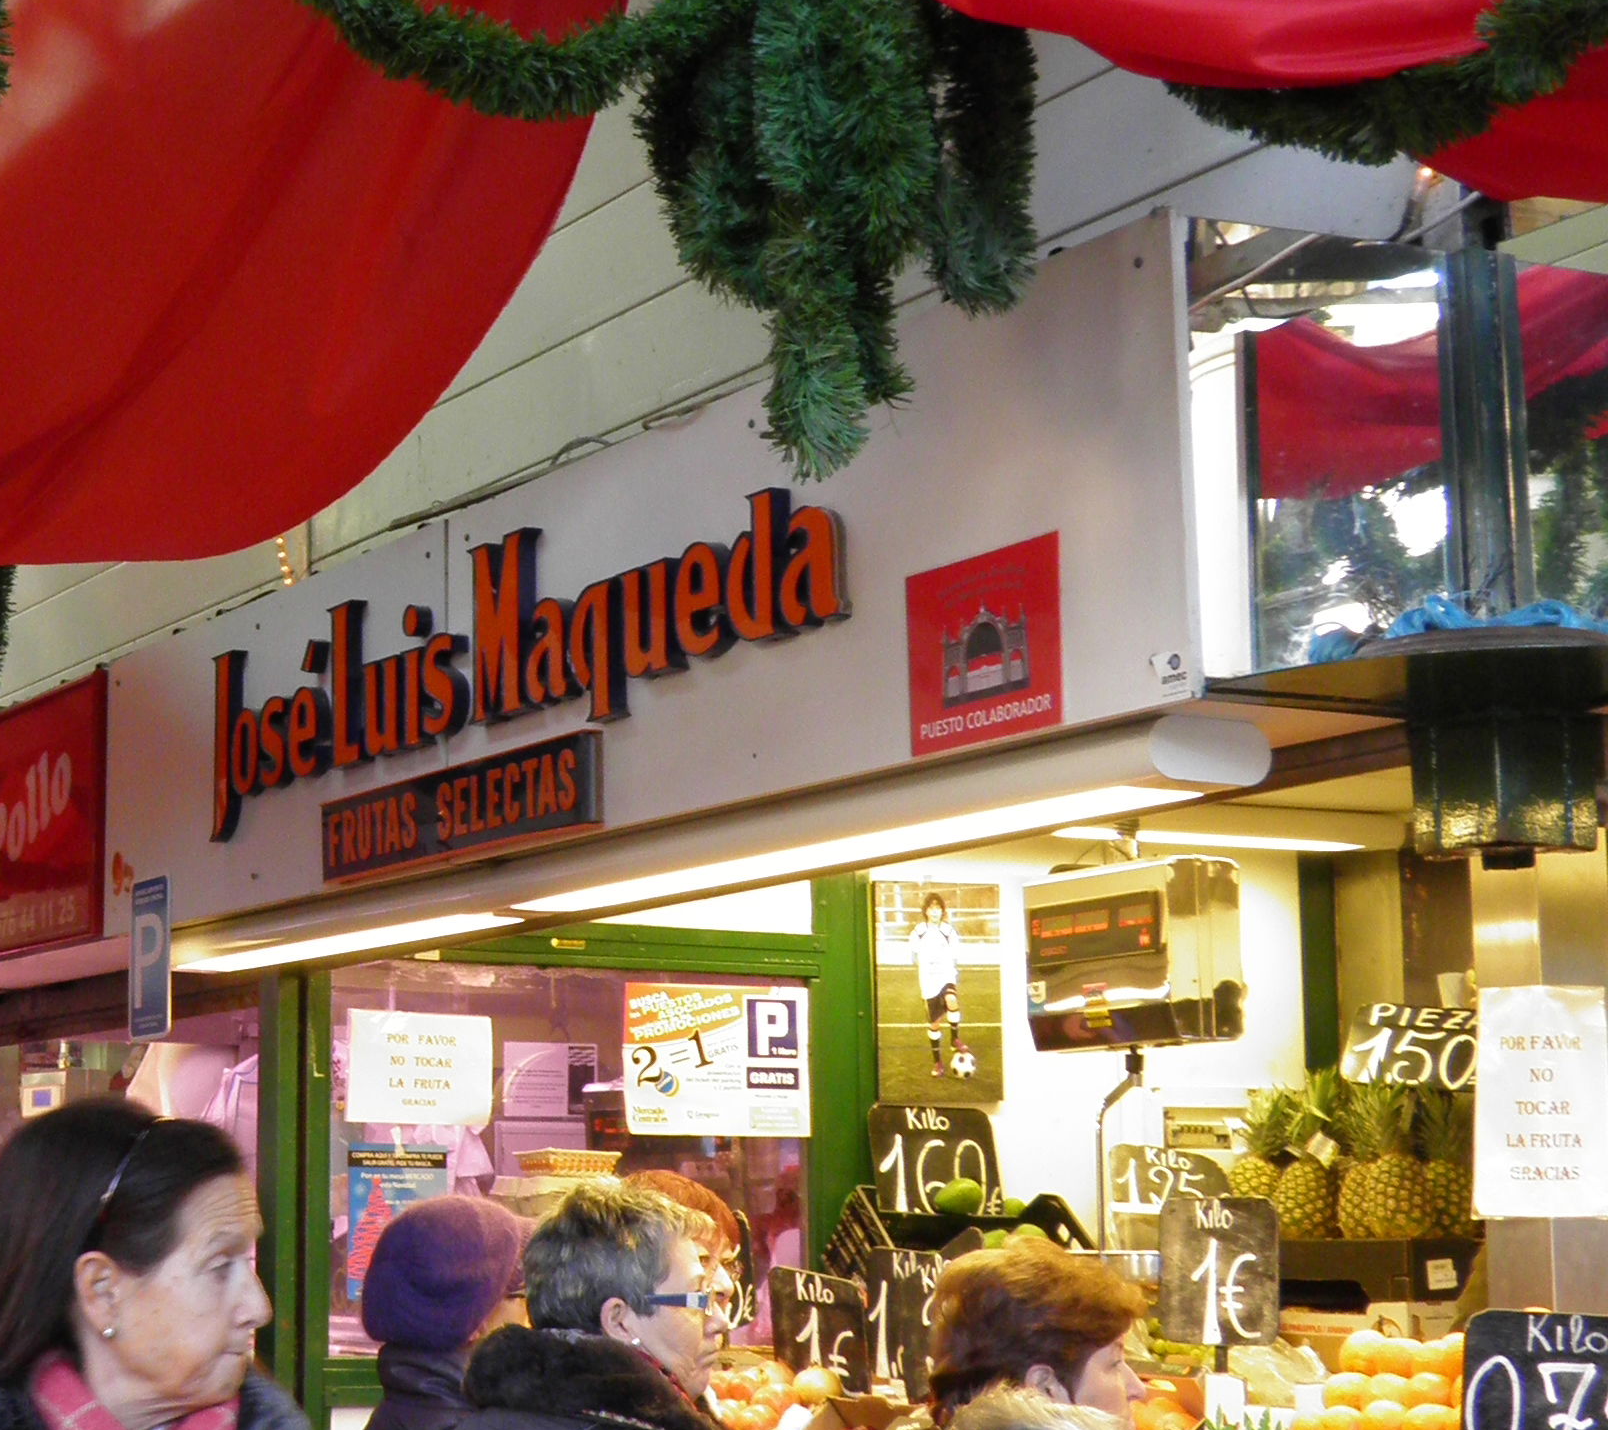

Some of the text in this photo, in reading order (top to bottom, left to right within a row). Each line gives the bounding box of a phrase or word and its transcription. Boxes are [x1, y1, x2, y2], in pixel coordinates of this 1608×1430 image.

[211, 487, 853, 842] José Luis Maqueda
[920, 693, 1053, 740] PUESTO COLABORADOR
[327, 747, 577, 868] FRUTAS SELECTAS
[134, 912, 164, 1009] P
[387, 1033, 457, 1047] POR FAVOR
[756, 1001, 789, 1056] P
[1500, 1034, 1582, 1051] POR FAVOR
[390, 1056, 453, 1069] NO TOCAR
[388, 1077, 452, 1090] LA FRUTA
[750, 1071, 795, 1086] GRATIS
[1529, 1068, 1554, 1083] NO
[401, 1098, 437, 1107] GRACIAS
[1515, 1100, 1571, 1116] TOCAR
[905, 1107, 950, 1131] Kilo
[1506, 1133, 1583, 1148] LA FRUTA
[1145, 1146, 1192, 1170] Kilo
[1510, 1166, 1580, 1181] GRACIAS
[1195, 1199, 1233, 1229] Kilo
[892, 1251, 921, 1280] Kil
[795, 1272, 834, 1304] Kilo
[1526, 1314, 1608, 1354] Kilo
